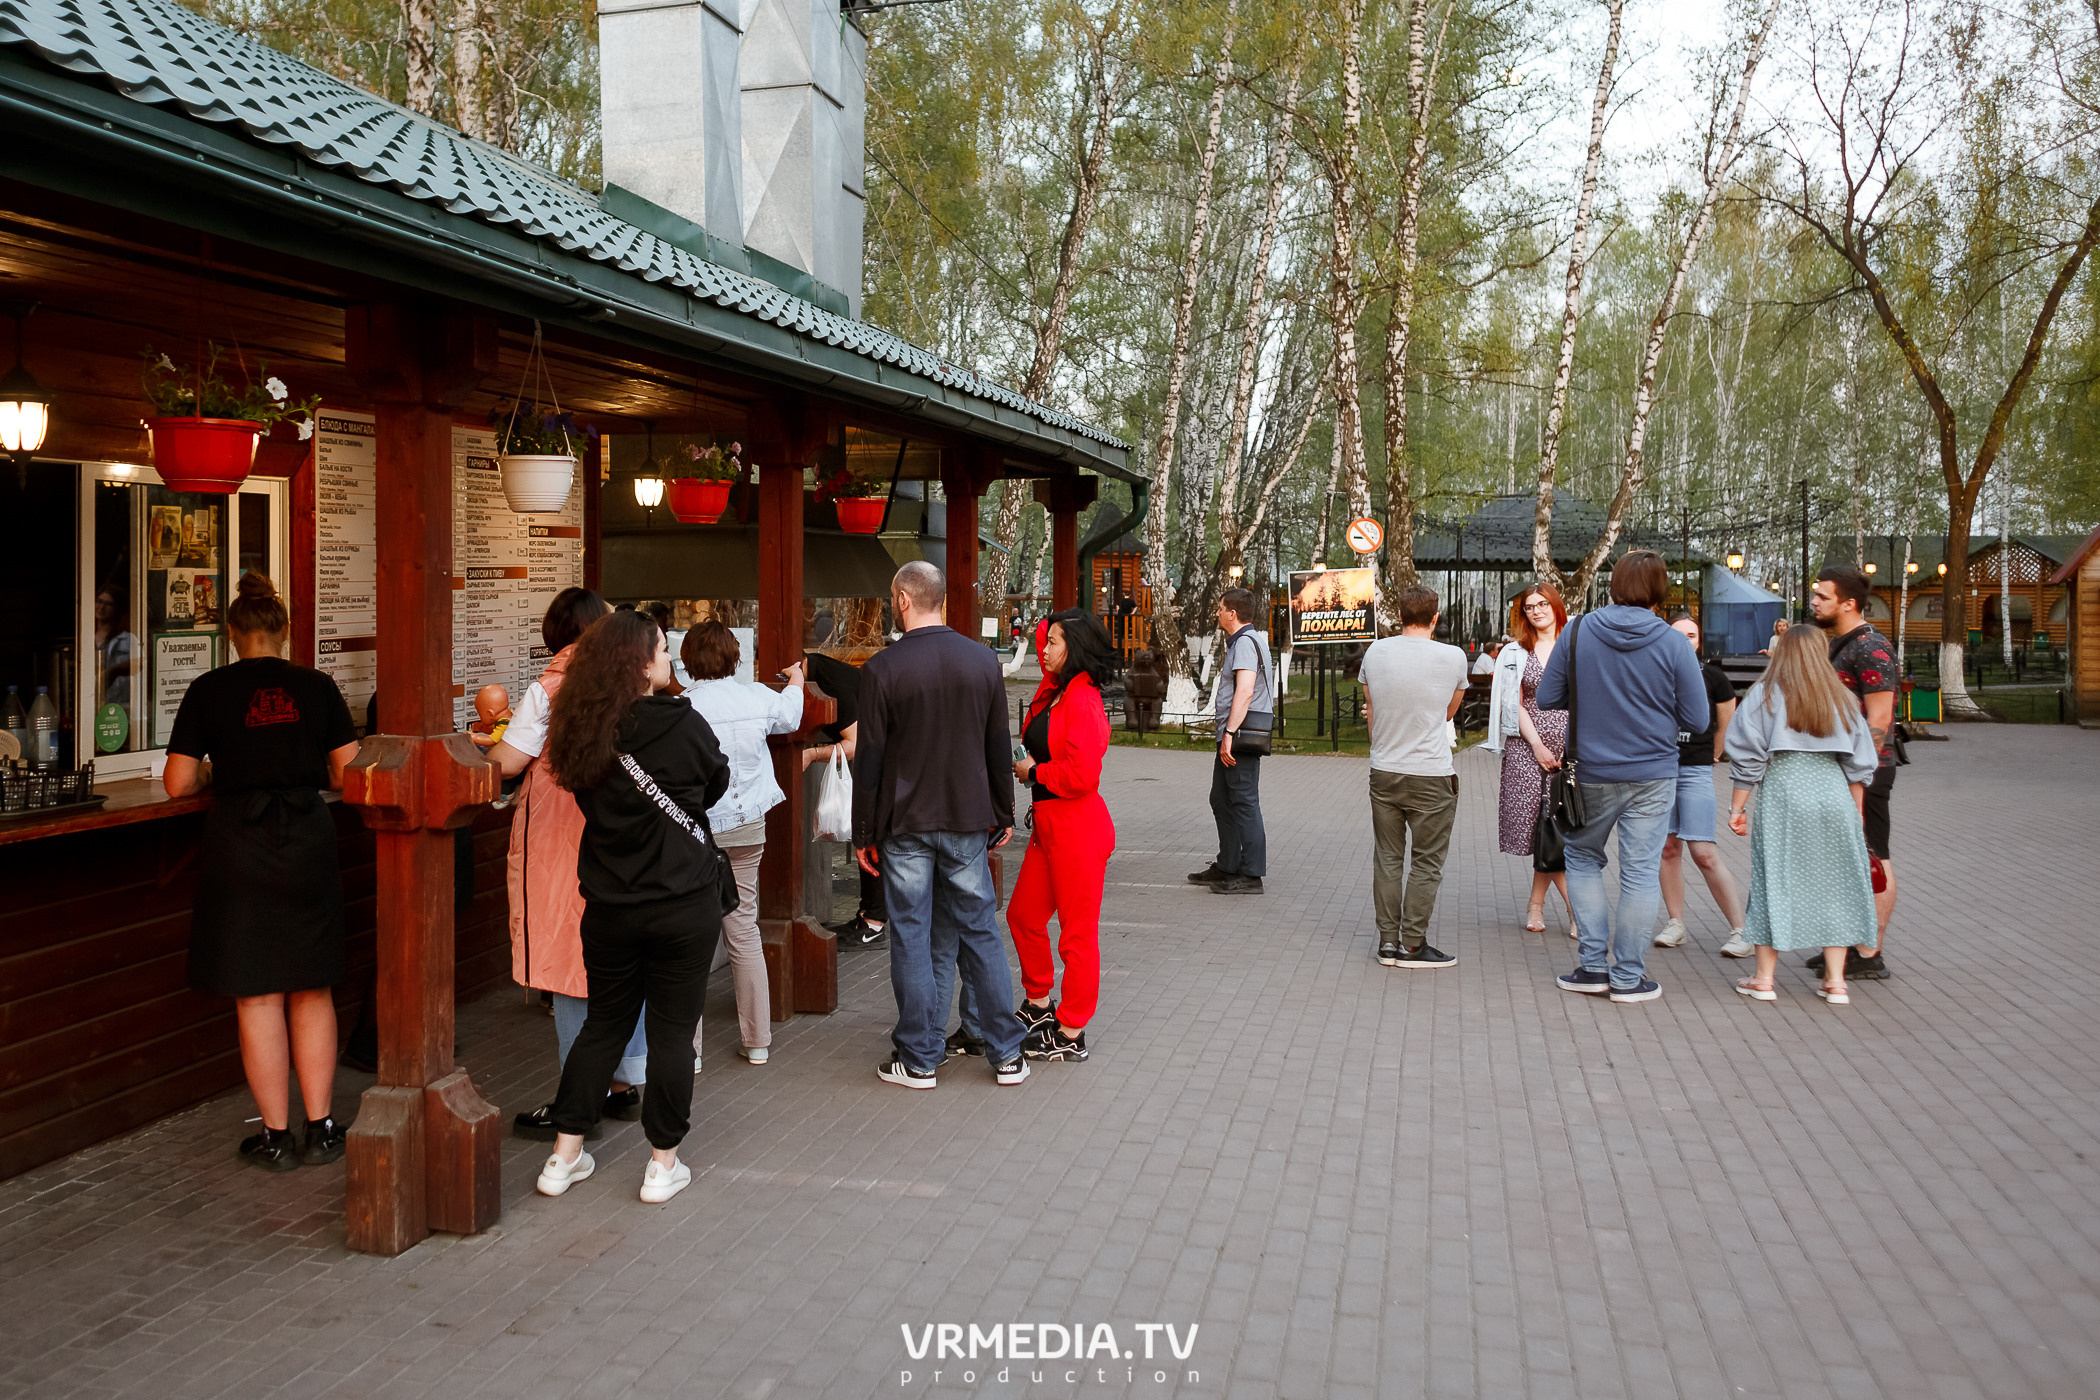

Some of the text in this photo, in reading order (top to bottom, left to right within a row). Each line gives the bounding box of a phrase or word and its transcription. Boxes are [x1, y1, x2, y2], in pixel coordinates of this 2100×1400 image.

[320, 419, 343, 432] БЛЮДА
[1301, 609, 1367, 620] БЕРЕГИТЕ ЛЕС ОТ
[1300, 617, 1366, 633] ПОЖАРА!
[162, 640, 207, 653] Уважаемые
[320, 641, 342, 652] СОУСЫ
[173, 653, 197, 667] гости!
